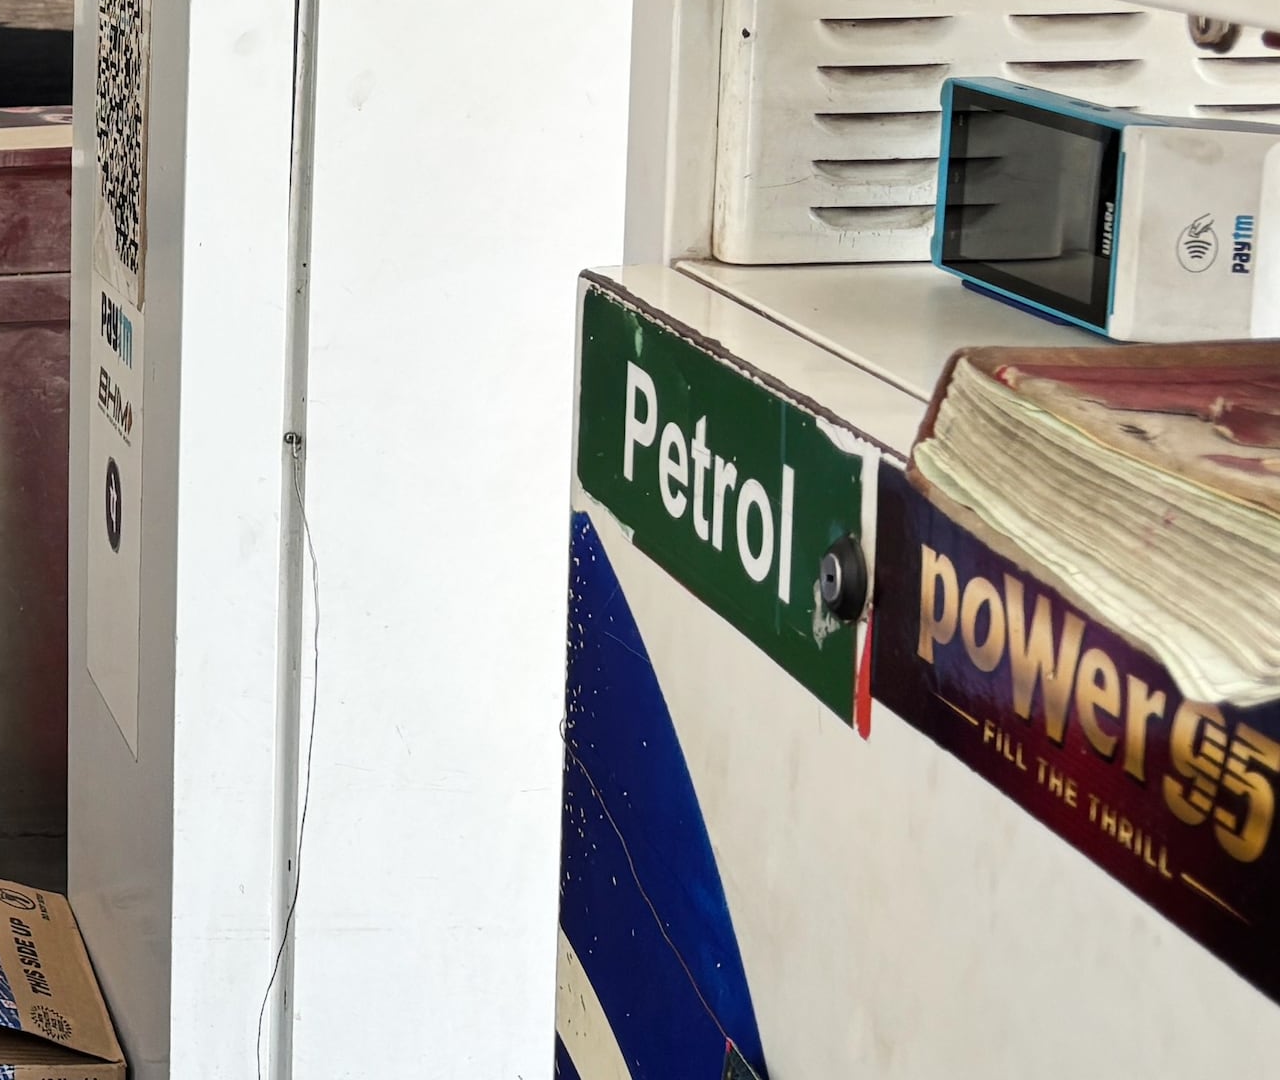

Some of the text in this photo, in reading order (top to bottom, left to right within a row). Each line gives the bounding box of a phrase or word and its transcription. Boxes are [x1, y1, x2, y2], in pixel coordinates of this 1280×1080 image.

[622, 358, 797, 608] Petrol
[983, 719, 1173, 879] FILL THE THRILL
[9, 917, 52, 997] THIS SIDE UP
